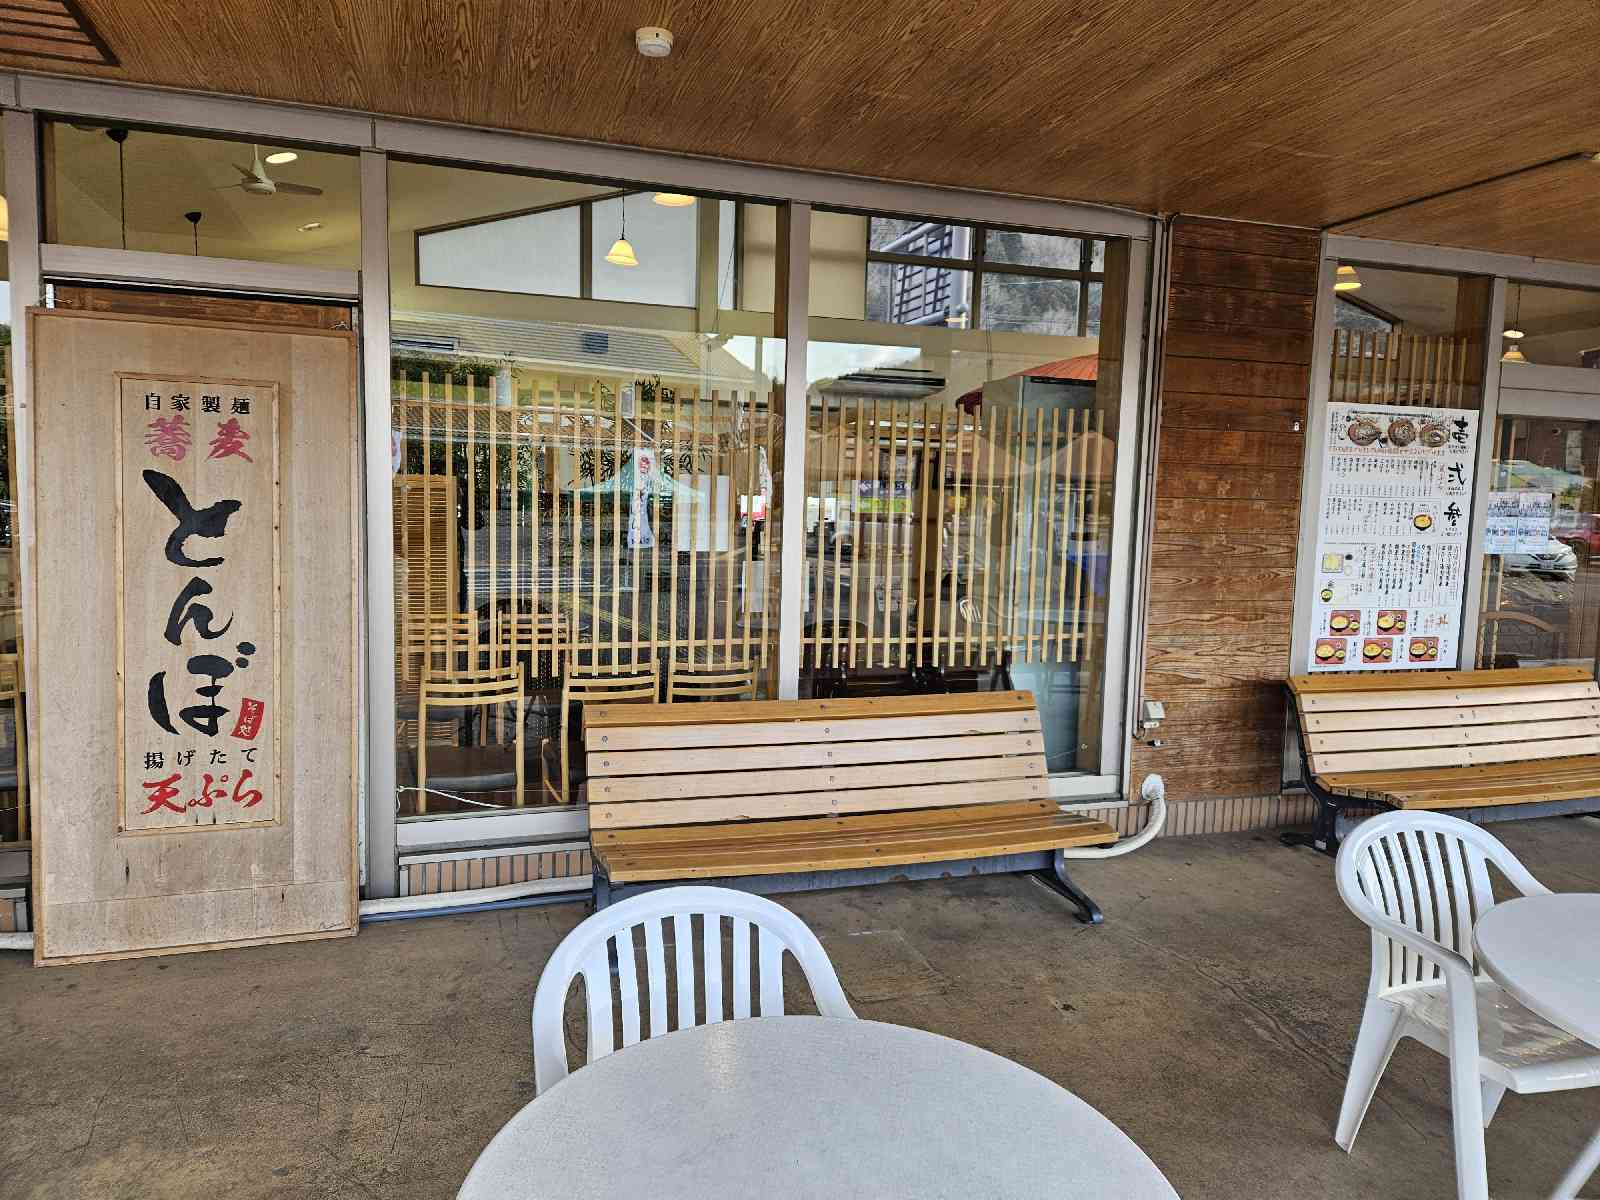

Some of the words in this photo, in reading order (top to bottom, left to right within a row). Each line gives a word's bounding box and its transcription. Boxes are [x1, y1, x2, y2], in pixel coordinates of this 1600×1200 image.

[145, 392, 250, 414] 自家製麺
[144, 415, 254, 463] 蕎麦
[142, 469, 256, 736] とんぼ
[143, 747, 257, 770] 揚げたて
[140, 768, 262, 814] 天ぷら
